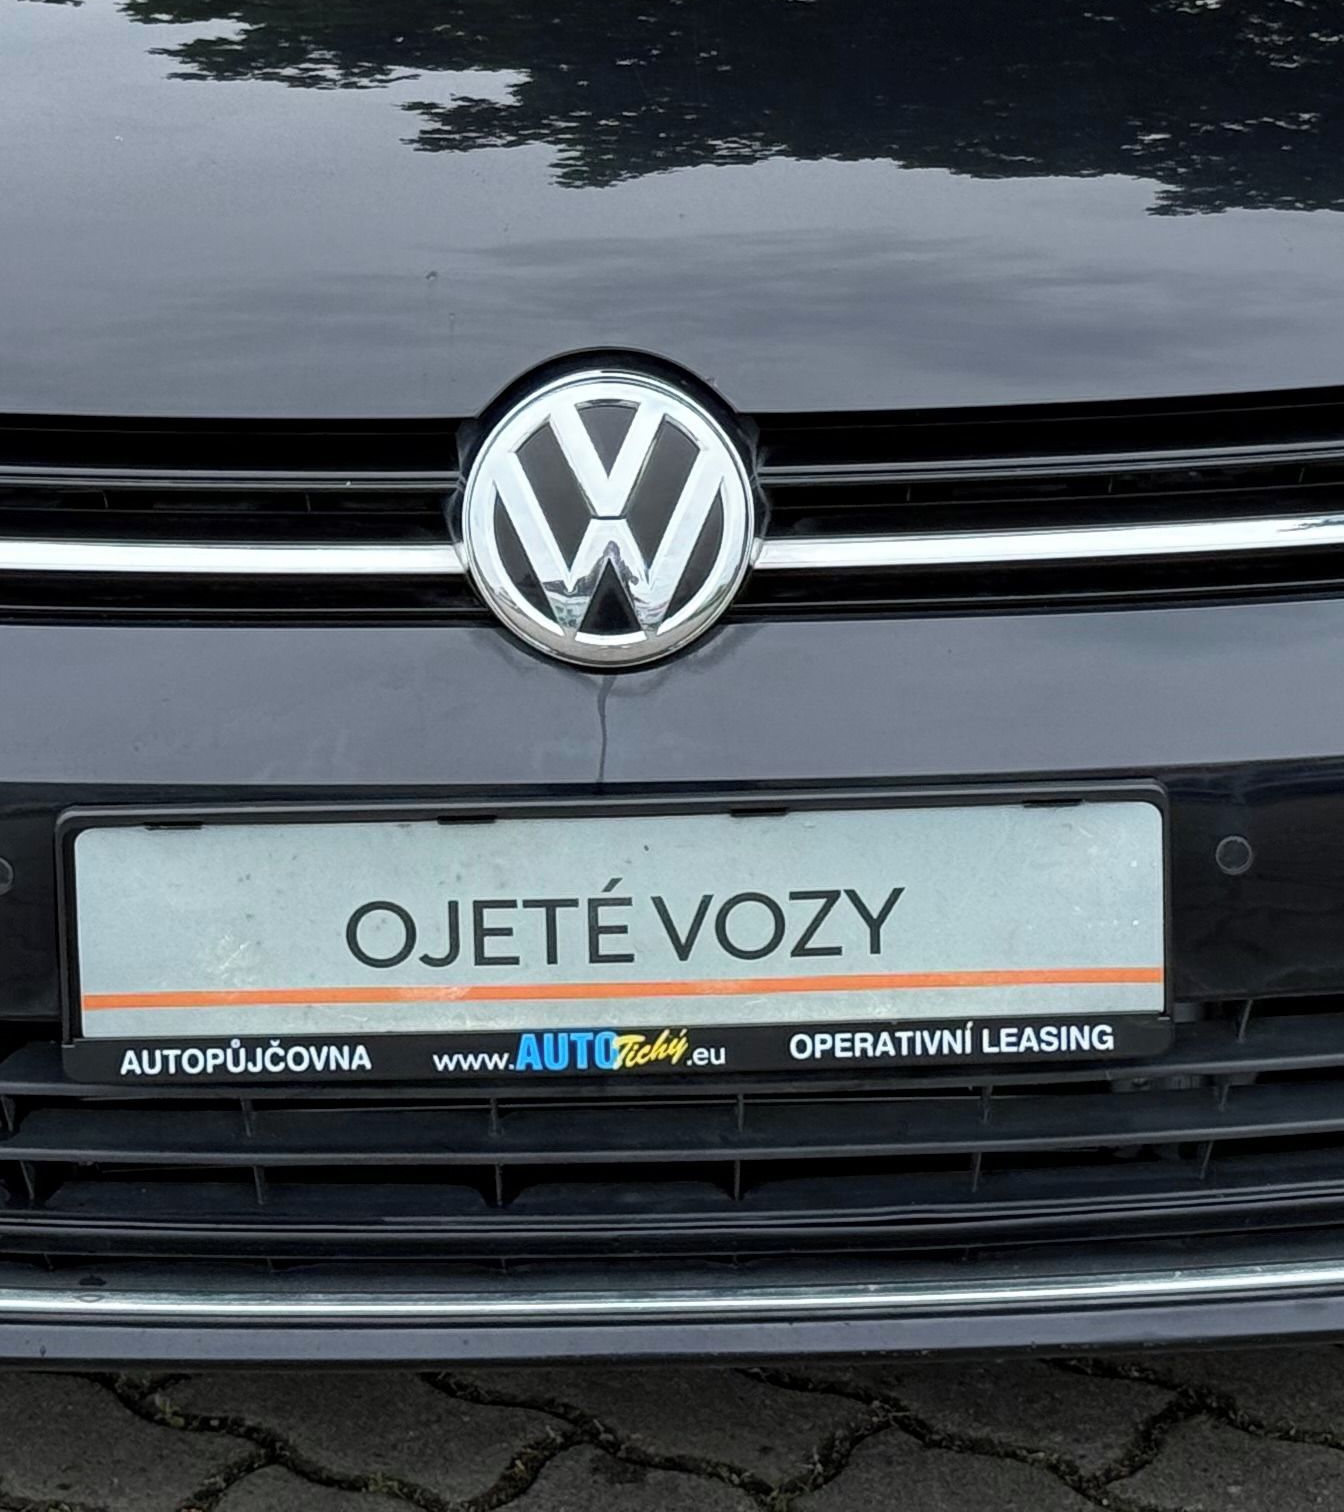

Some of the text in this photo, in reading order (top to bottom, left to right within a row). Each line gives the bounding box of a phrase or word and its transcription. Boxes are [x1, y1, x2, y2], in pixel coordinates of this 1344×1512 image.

[345, 878, 906, 969] OJETÉ VOZY
[119, 1037, 372, 1077] AUTOPŮJČOVNA
[788, 1020, 1116, 1060] OPERATIVNÍ LEASING
